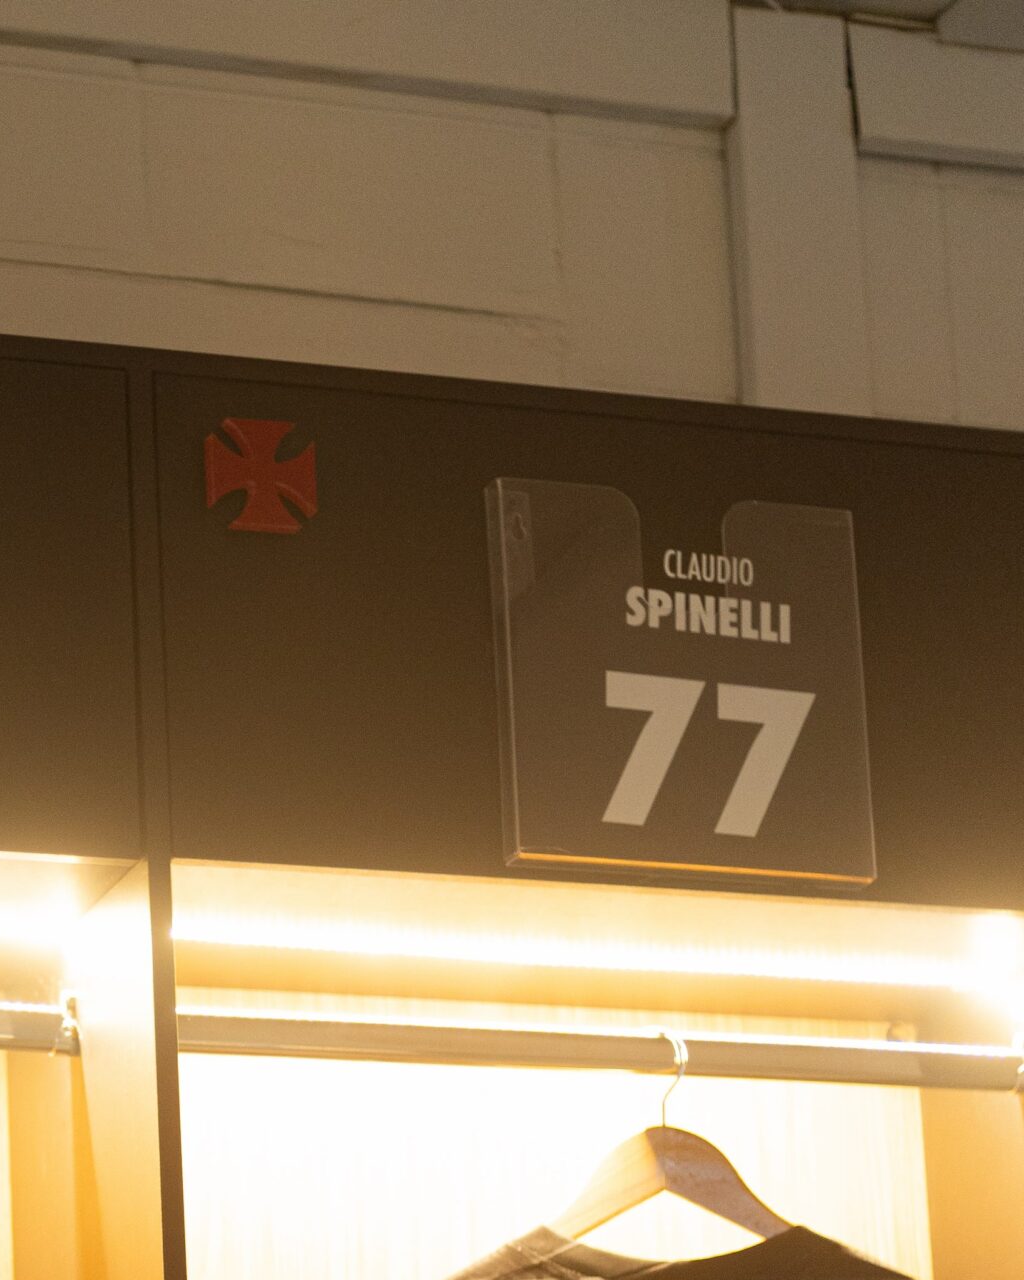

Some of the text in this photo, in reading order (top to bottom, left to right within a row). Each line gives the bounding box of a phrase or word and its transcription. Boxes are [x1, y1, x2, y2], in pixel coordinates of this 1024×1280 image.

[664, 550, 754, 587] CLAUDIO
[626, 586, 791, 644] SPINELLI
[602, 670, 816, 838] 77
